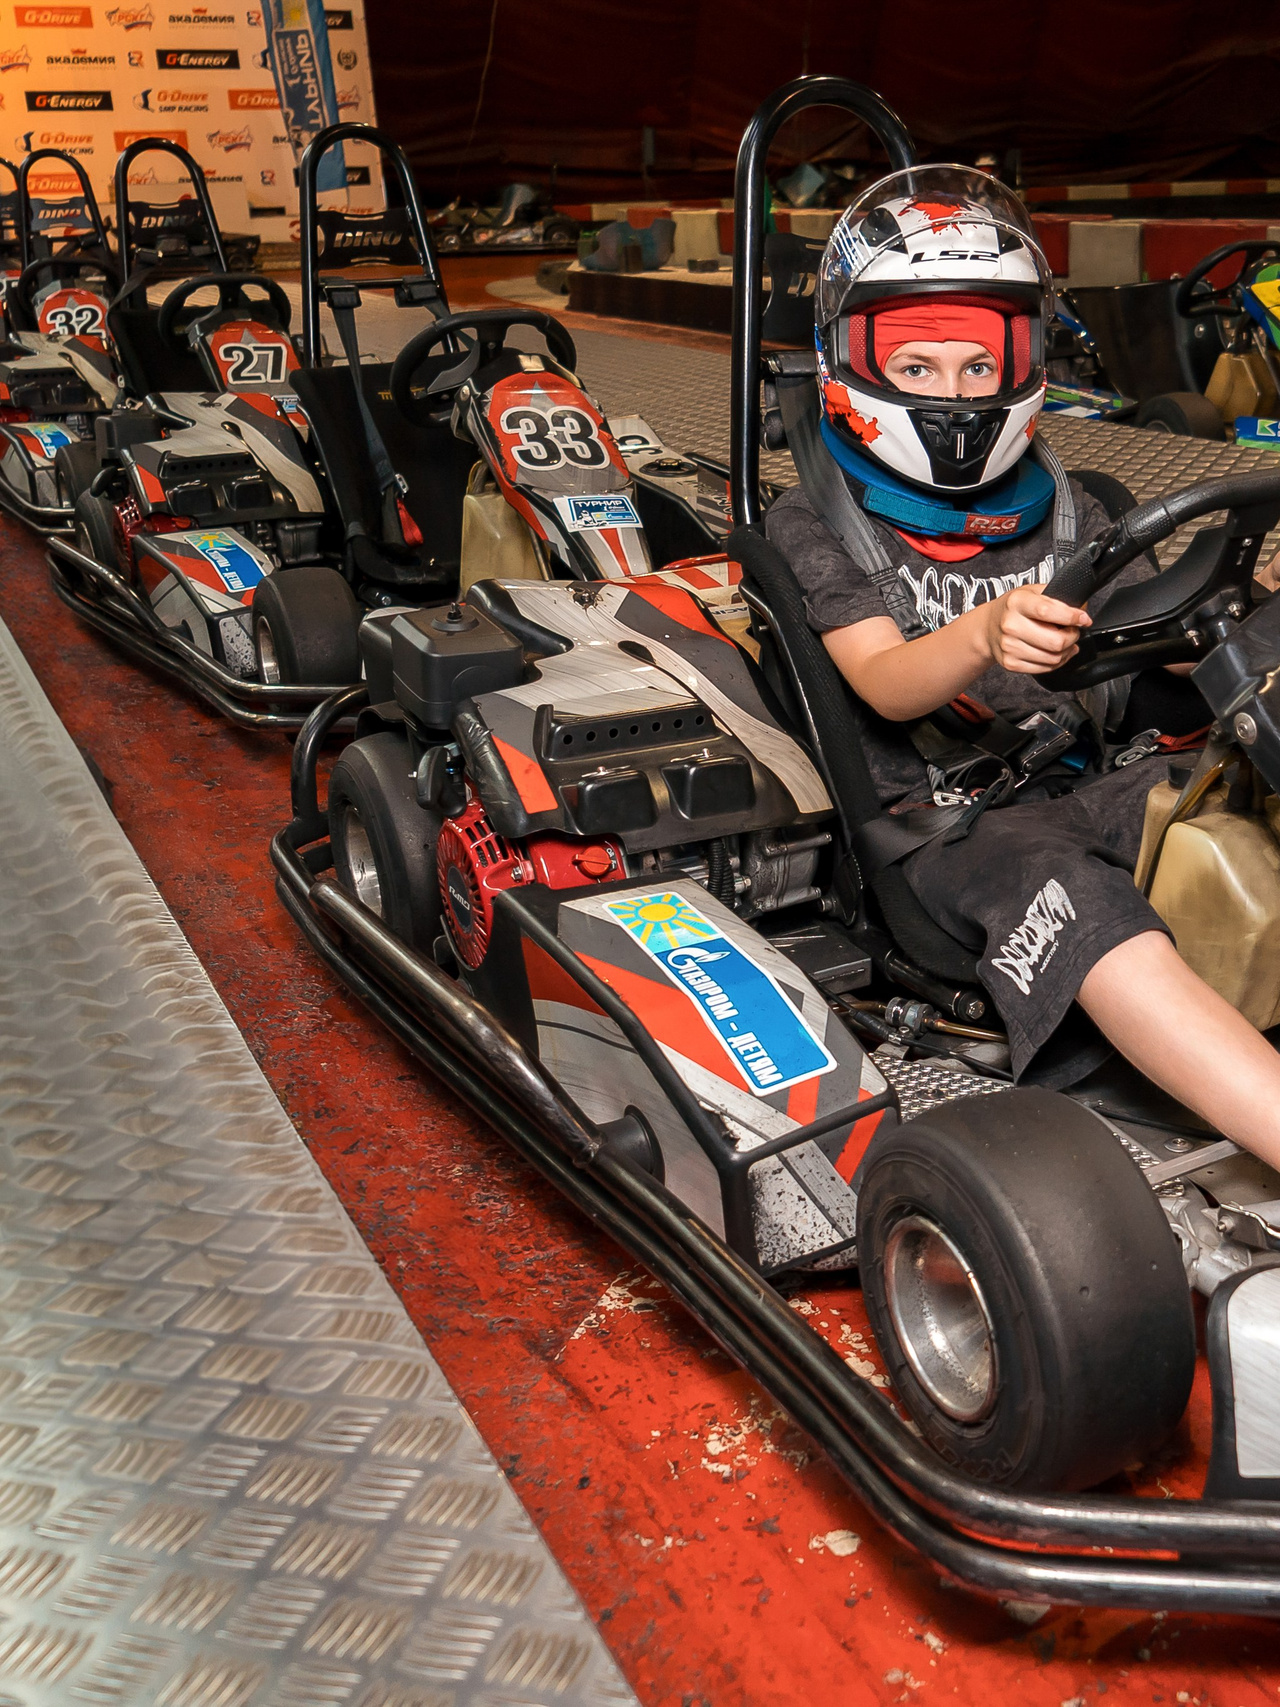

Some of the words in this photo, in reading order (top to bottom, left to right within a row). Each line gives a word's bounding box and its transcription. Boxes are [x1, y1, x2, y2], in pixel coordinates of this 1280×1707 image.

[38, 209, 81, 219] DINO
[333, 231, 402, 248] DINO
[910, 250, 1000, 264] LS2
[46, 304, 106, 338] 32
[219, 342, 287, 385] 27
[501, 406, 610, 470] 33
